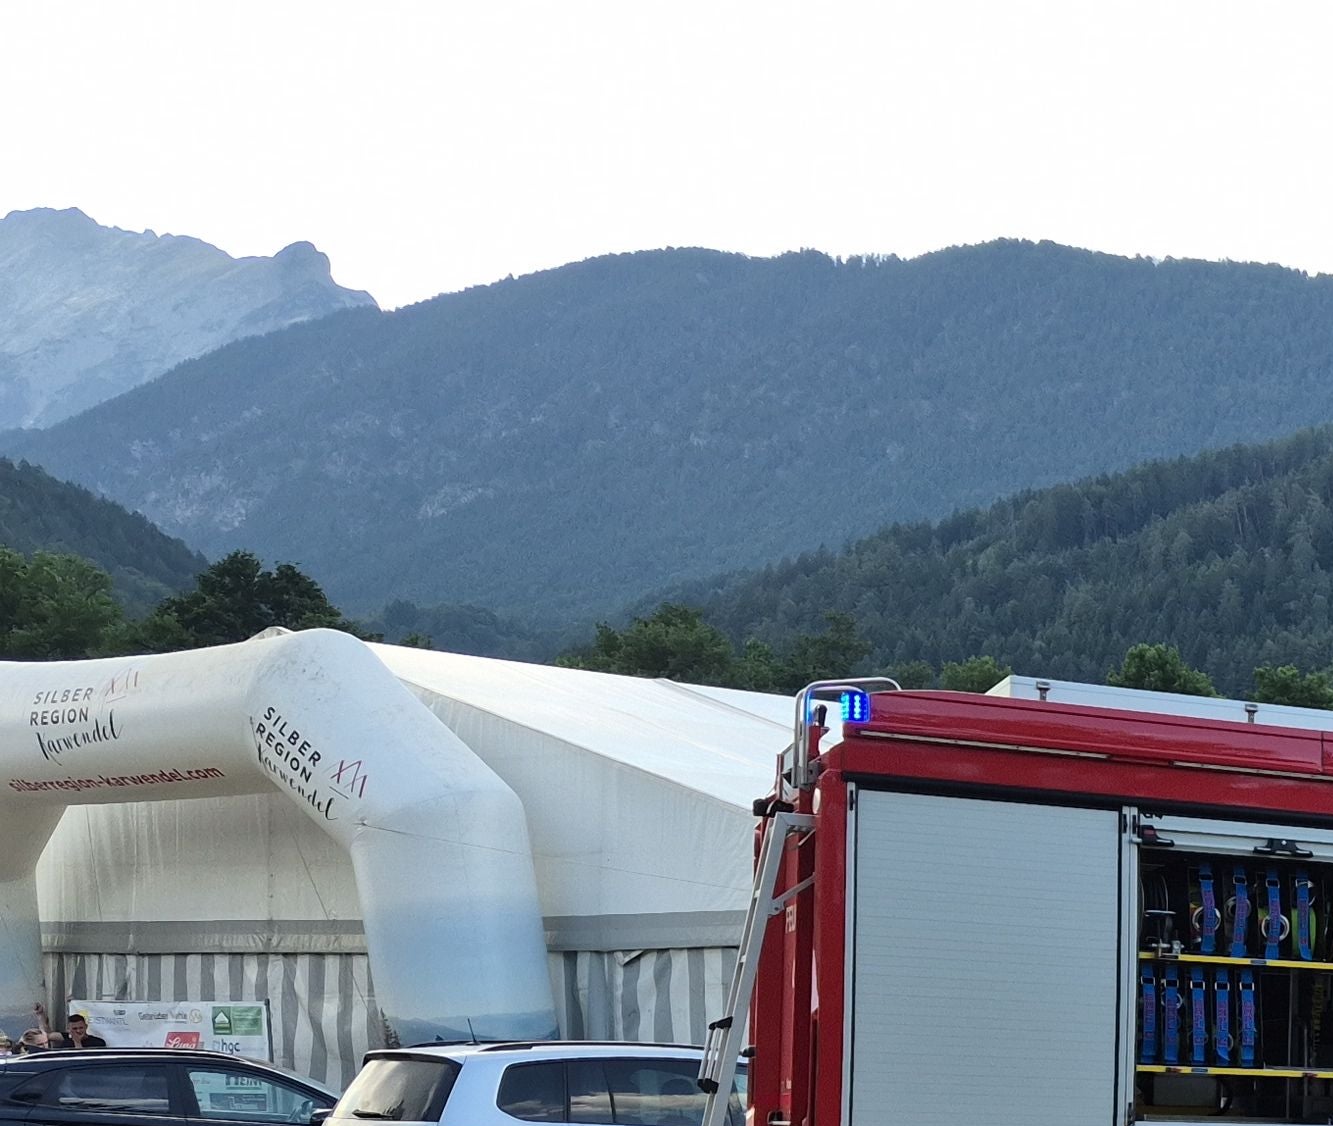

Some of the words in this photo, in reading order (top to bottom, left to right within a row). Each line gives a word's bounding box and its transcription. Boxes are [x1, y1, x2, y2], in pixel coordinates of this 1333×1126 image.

[30, 707, 89, 726] REGION
[33, 687, 95, 705] SILBER
[36, 709, 123, 766] Karwendel
[255, 722, 312, 783] REGION
[263, 706, 322, 768] SILBER
[9, 766, 225, 792] silberregion-karwendel.com
[257, 741, 338, 821] Karwendel
[221, 1039, 241, 1054] hgc
